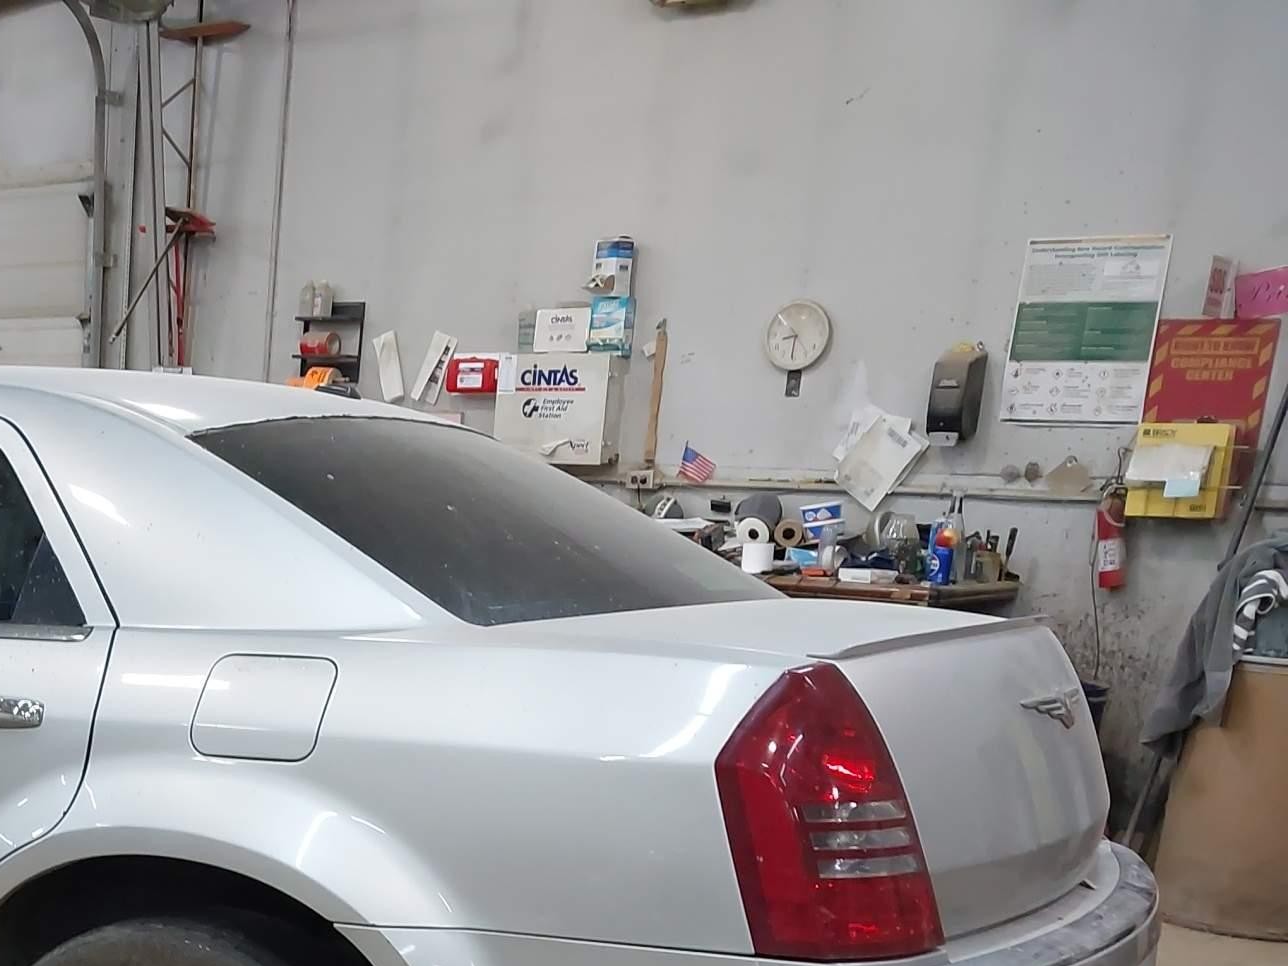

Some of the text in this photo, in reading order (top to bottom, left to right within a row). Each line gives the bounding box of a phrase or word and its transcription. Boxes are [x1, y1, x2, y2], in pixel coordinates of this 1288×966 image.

[550, 314, 573, 325] CINTAS
[1170, 357, 1253, 369] COMPLIANCE
[520, 363, 579, 387] CINTAS
[1185, 369, 1235, 381] CENTER
[542, 398, 575, 407] Employee
